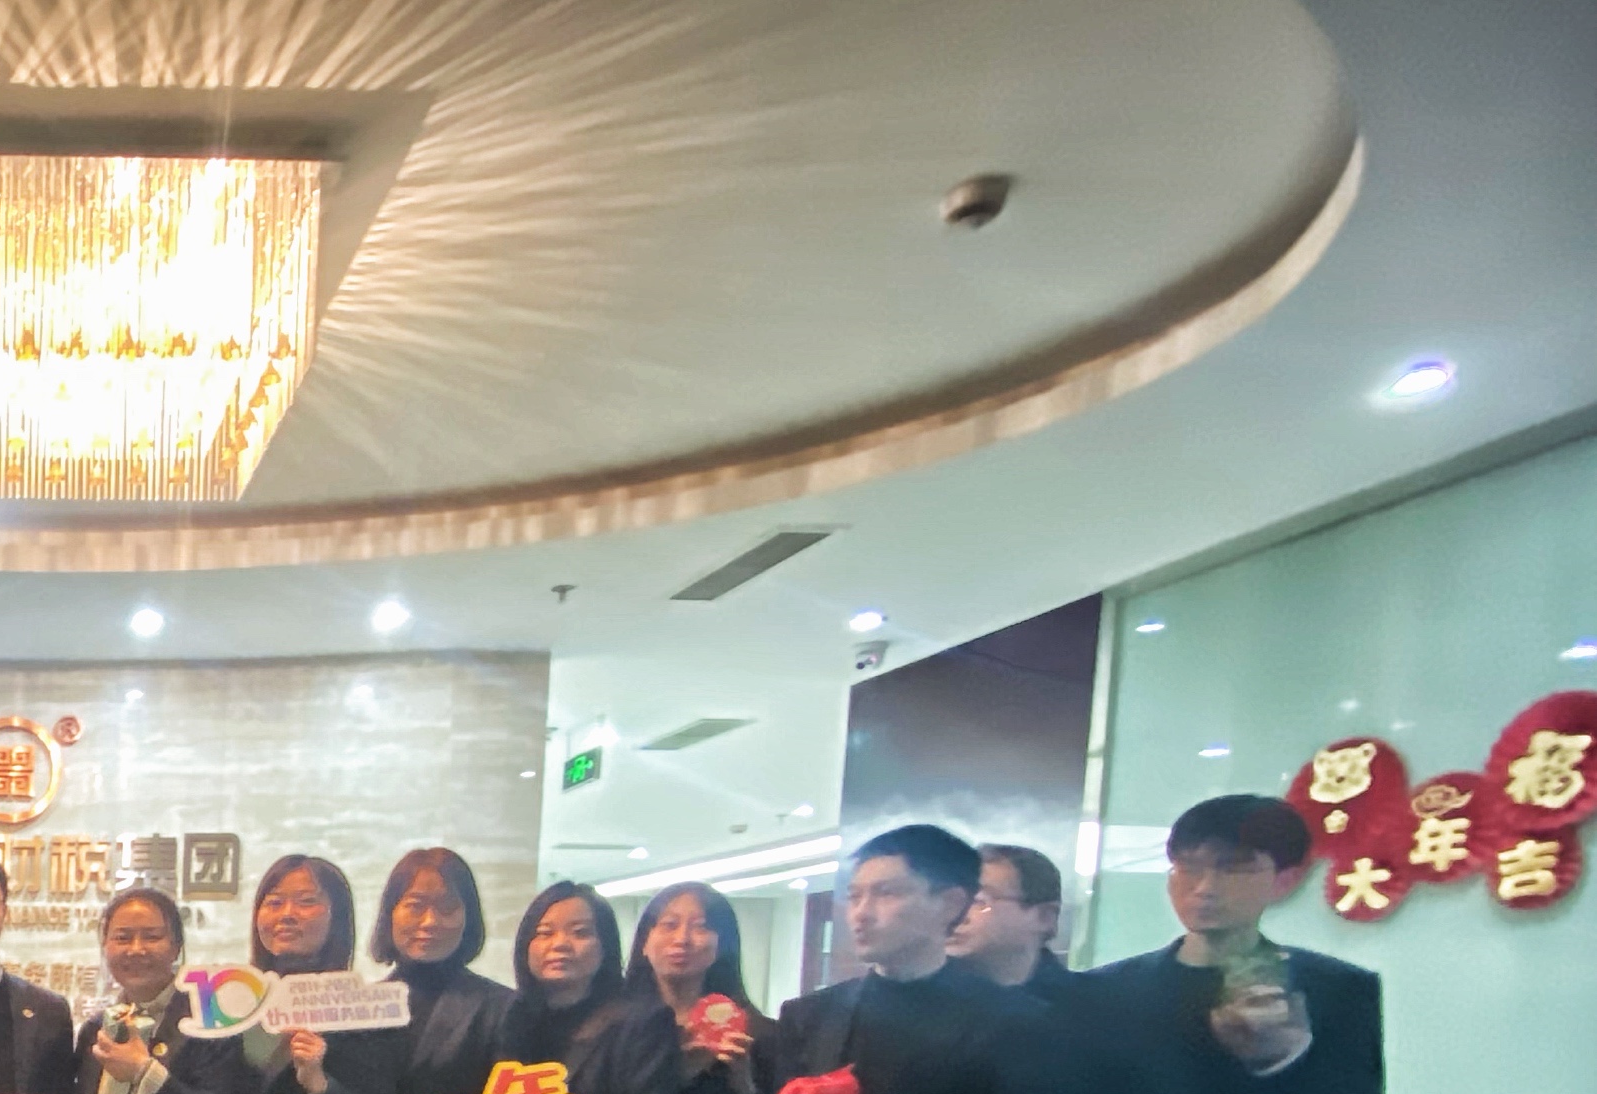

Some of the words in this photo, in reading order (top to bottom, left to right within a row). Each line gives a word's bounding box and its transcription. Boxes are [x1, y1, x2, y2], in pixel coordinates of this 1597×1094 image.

[1409, 818, 1471, 872] 年
[1498, 840, 1560, 900] 吉
[1335, 858, 1391, 912] 大
[184, 968, 264, 1029] 10
